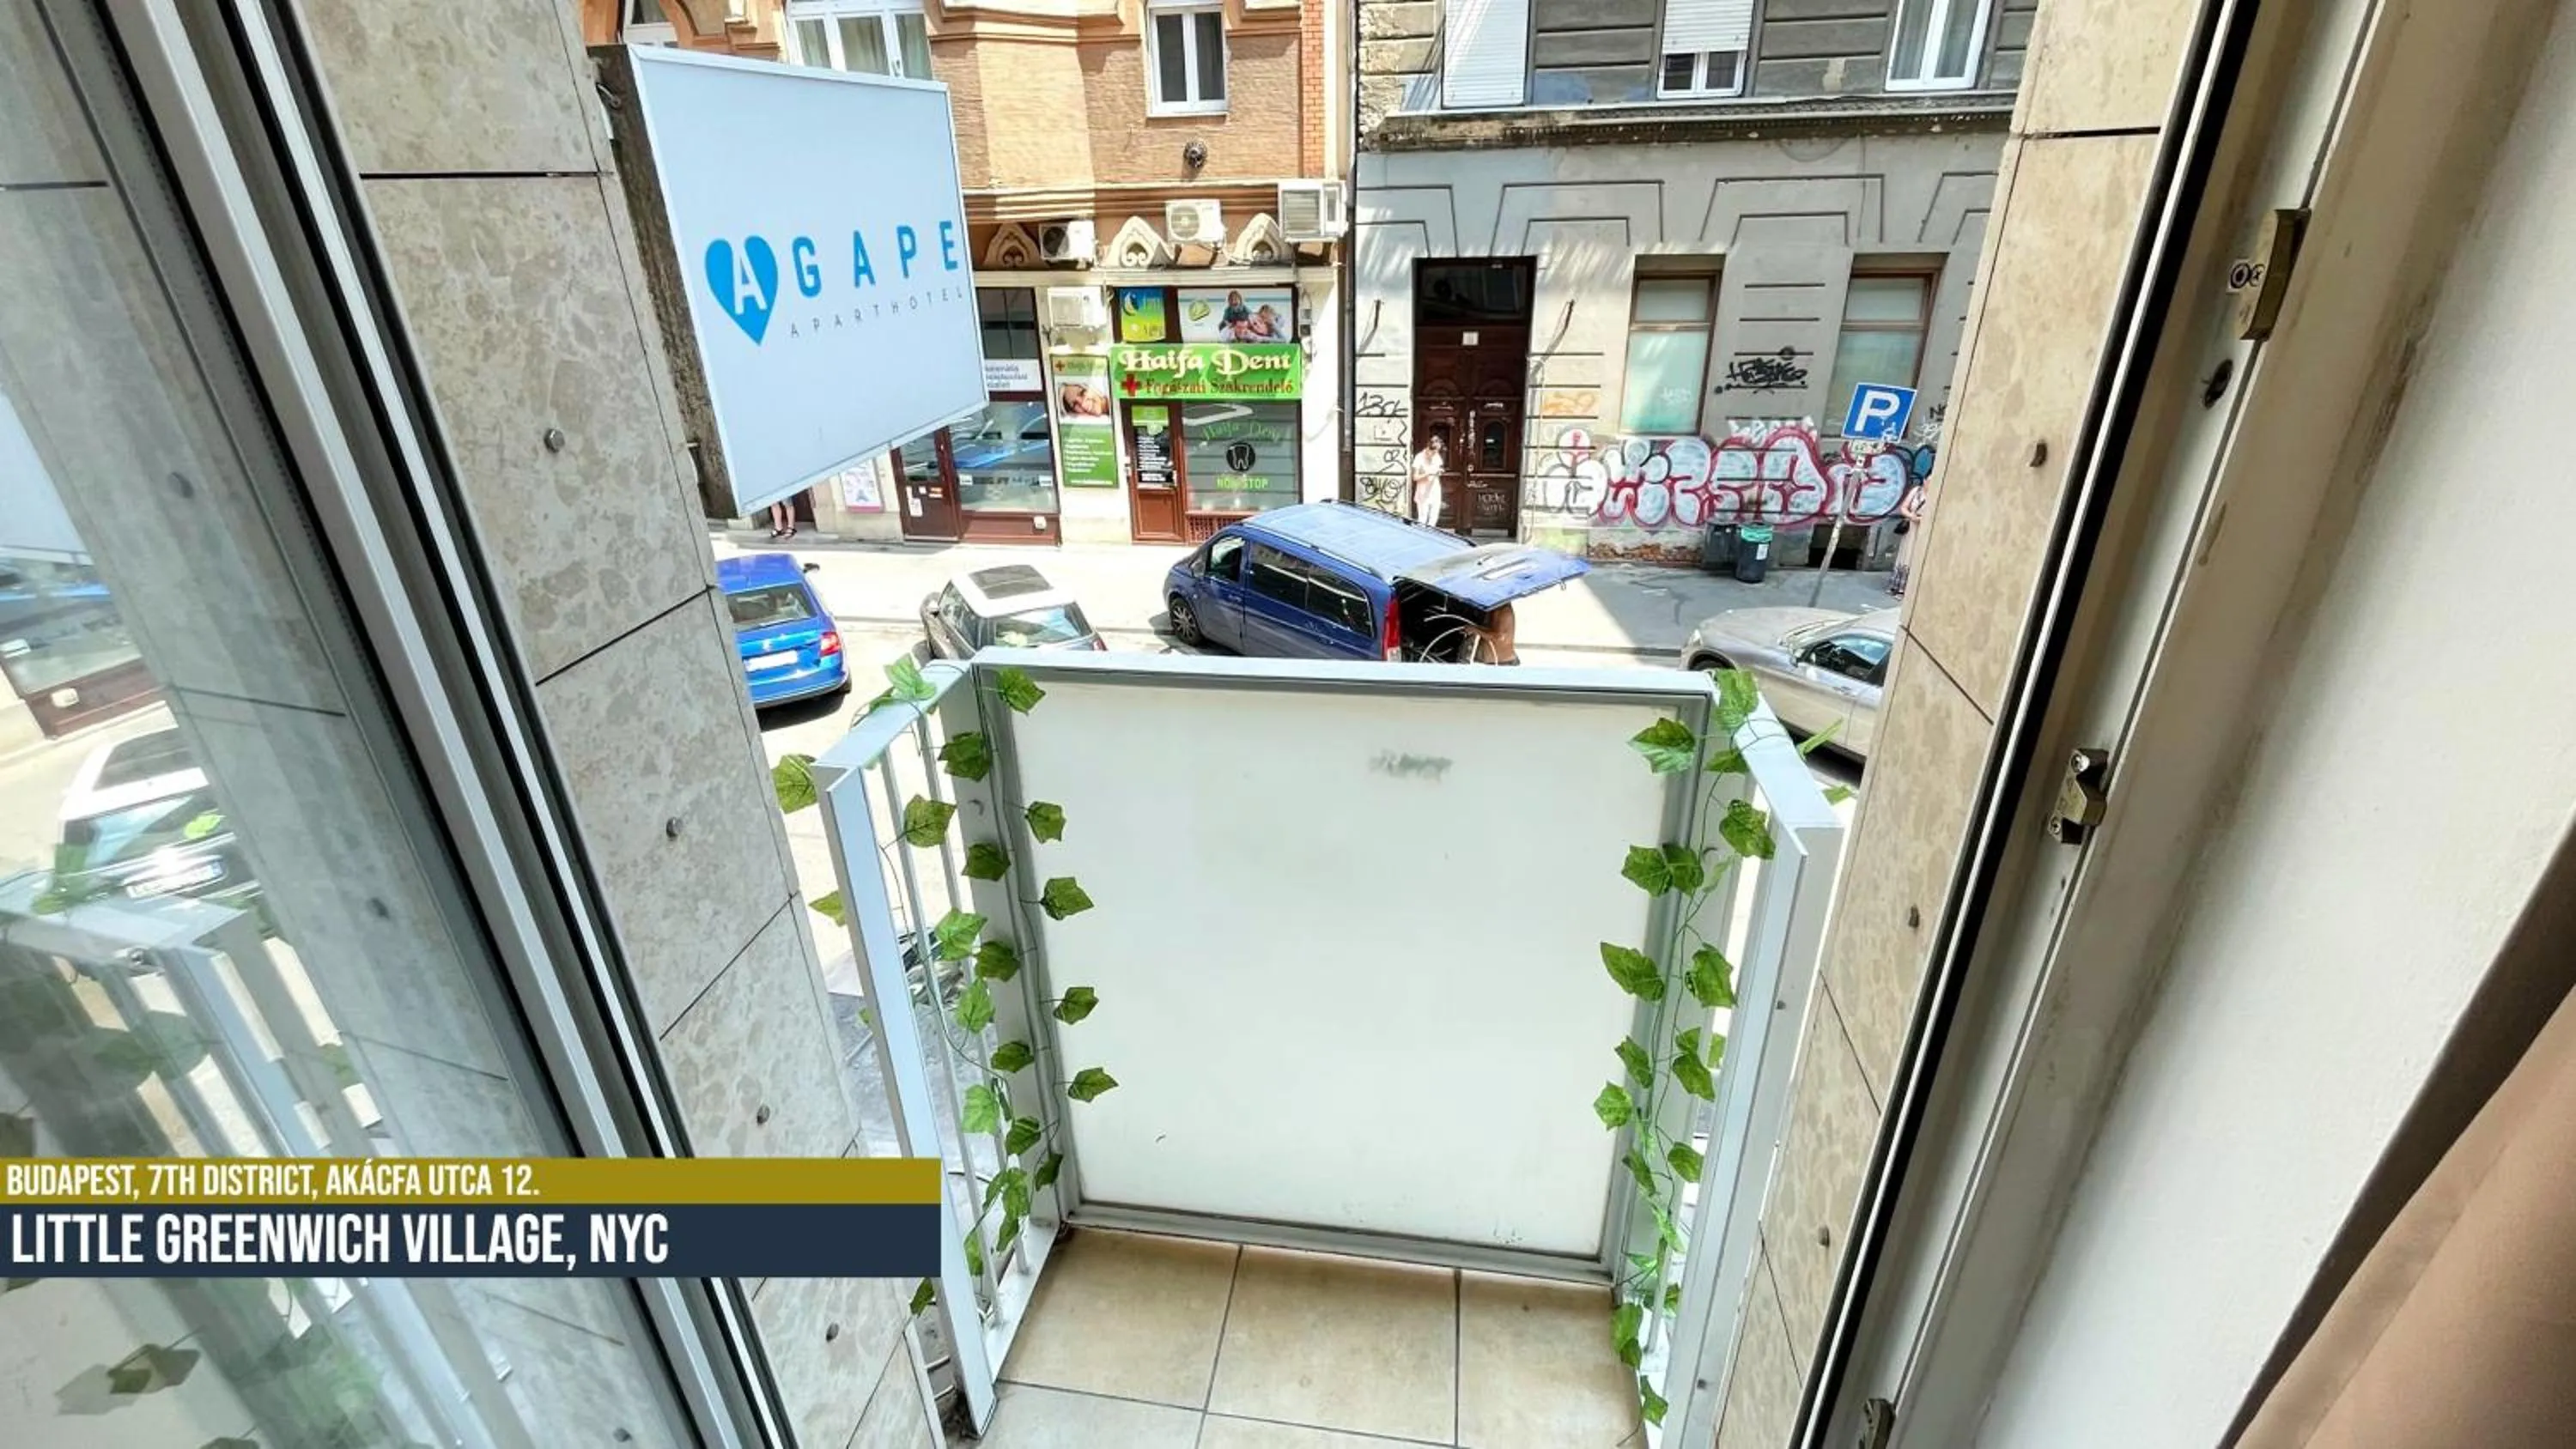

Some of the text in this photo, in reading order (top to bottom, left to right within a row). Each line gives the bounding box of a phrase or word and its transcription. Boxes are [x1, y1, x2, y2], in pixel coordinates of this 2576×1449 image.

[730, 220, 959, 315] AGAPE
[790, 287, 963, 338] APARTHOTEL
[1119, 349, 1291, 382] Haifa Dent
[1854, 391, 1900, 432] P
